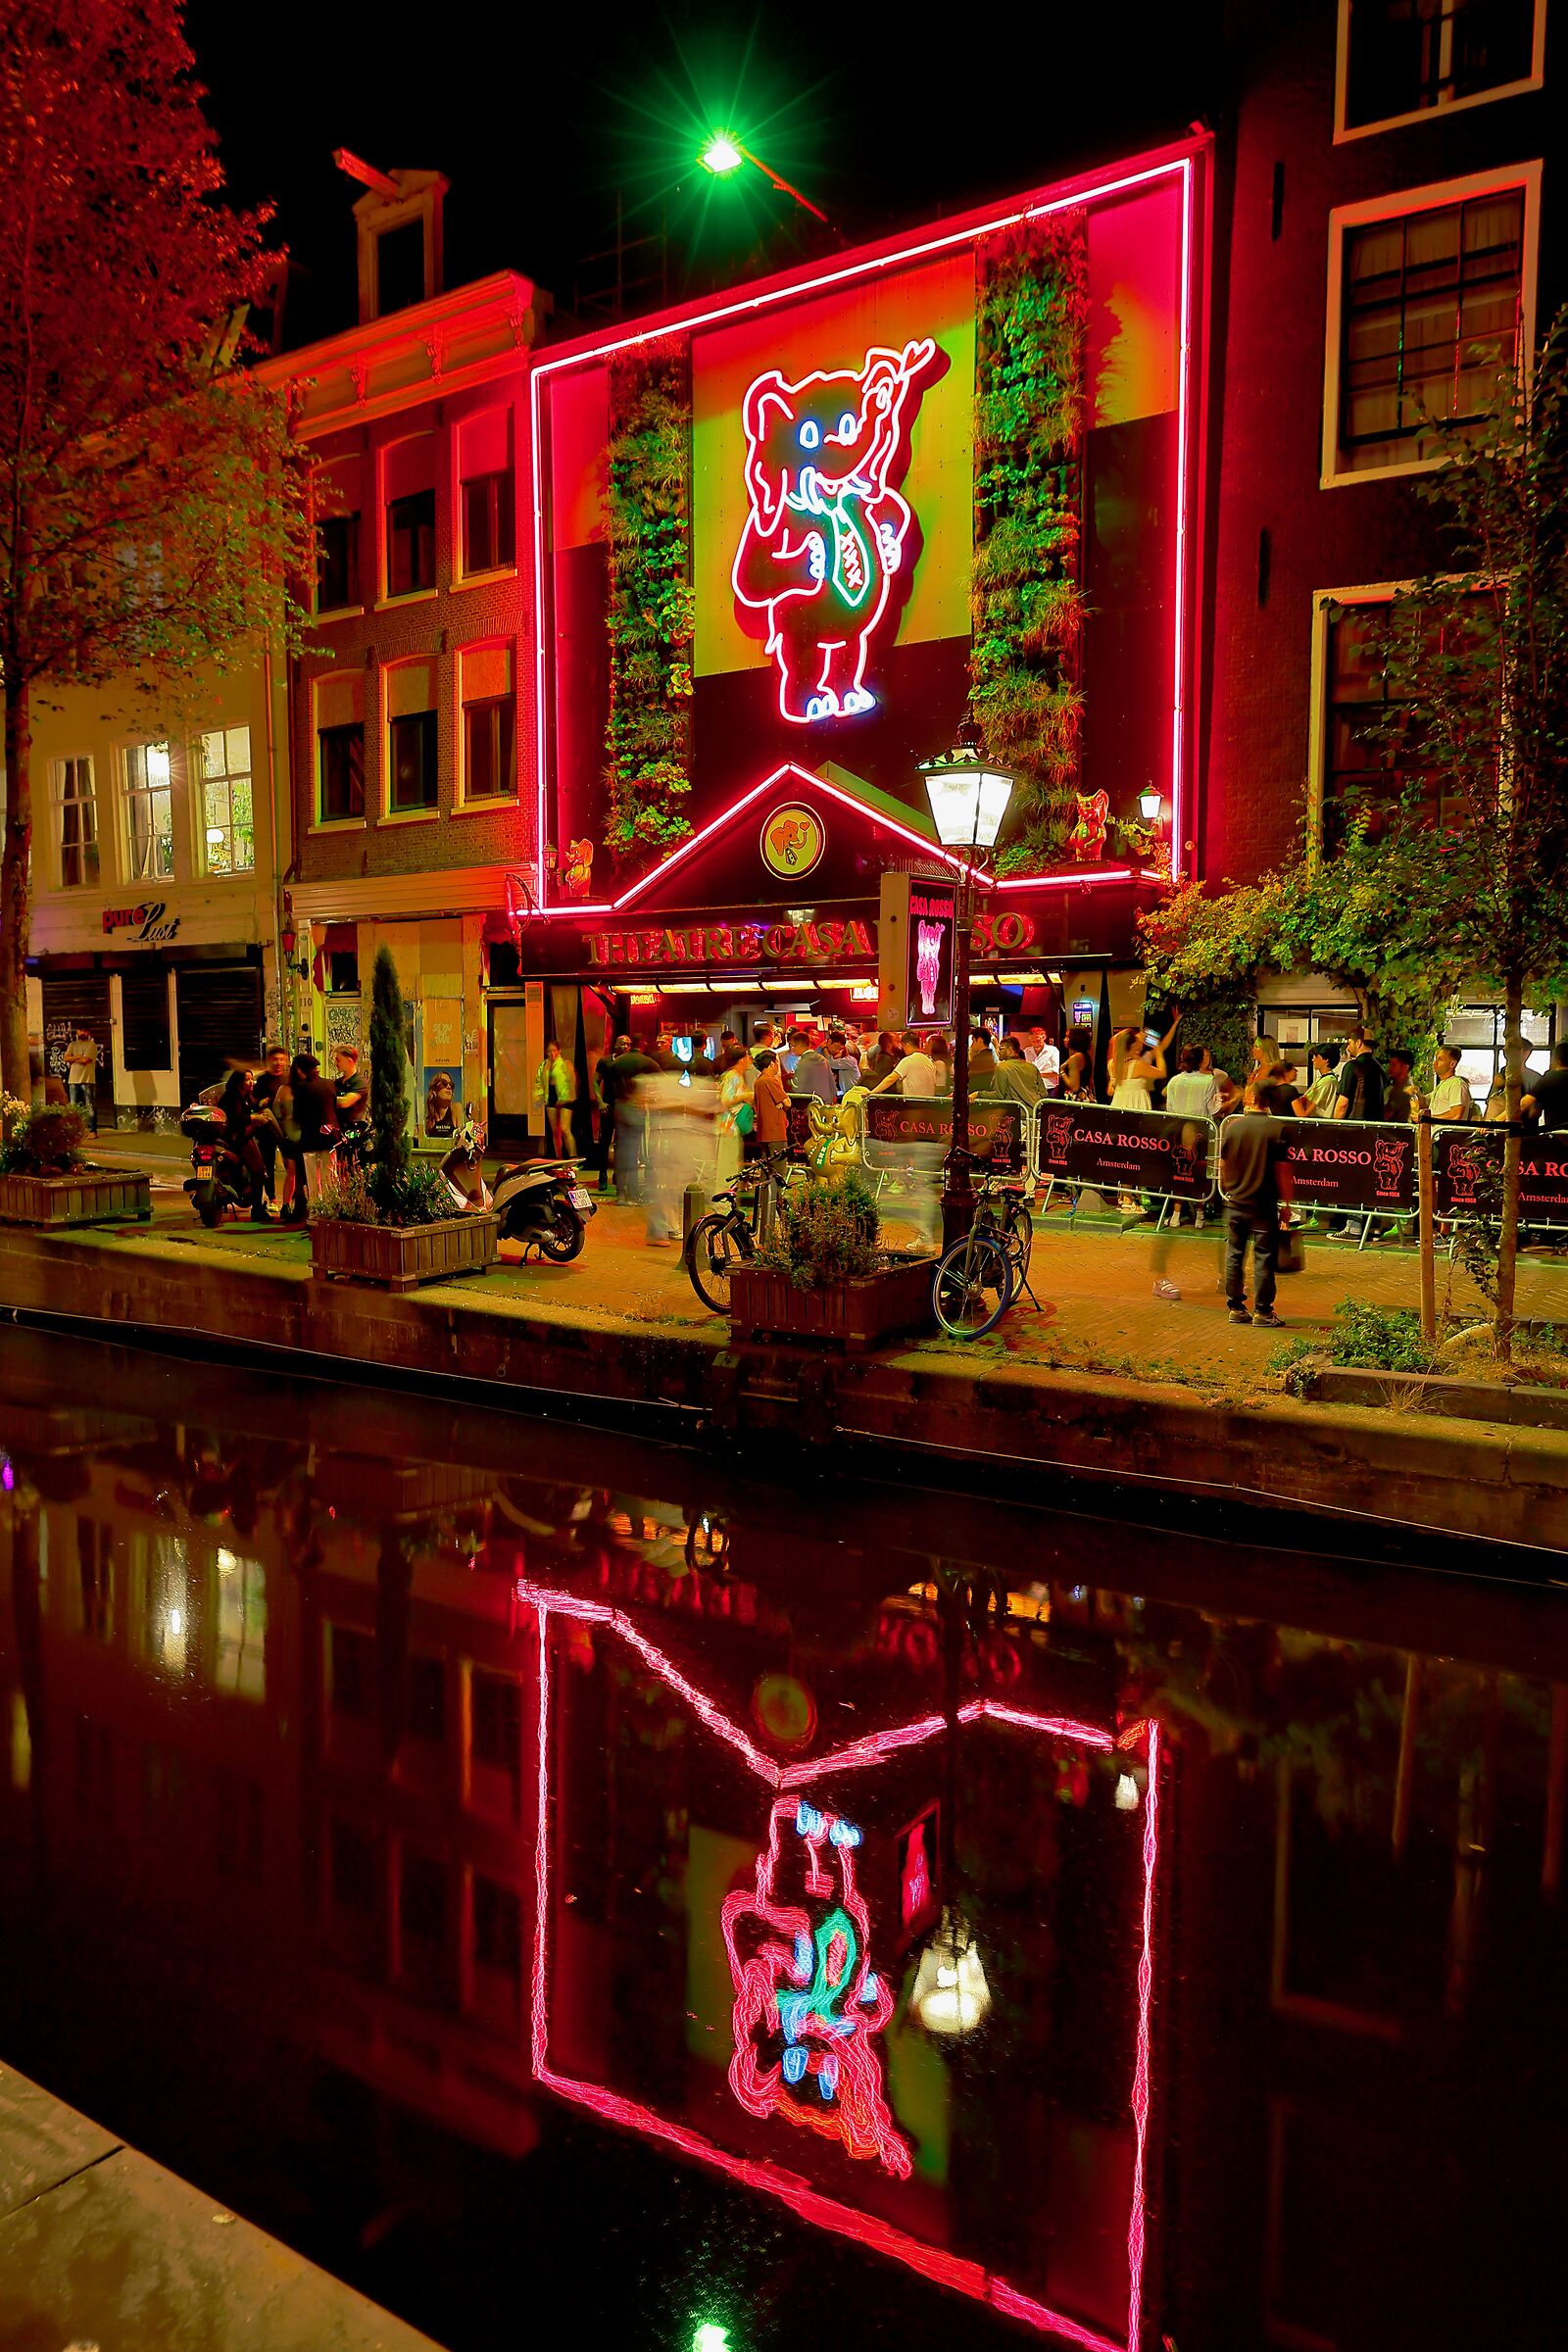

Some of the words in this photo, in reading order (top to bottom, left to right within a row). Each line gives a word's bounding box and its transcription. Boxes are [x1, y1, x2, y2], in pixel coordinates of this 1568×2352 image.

[909, 895, 928, 915] CASA
[102, 907, 146, 934] pure
[126, 902, 180, 942] Lust
[583, 927, 758, 964] THEATRE
[761, 920, 874, 959] CASA
[299, 997, 313, 1006] 110
[900, 1120, 935, 1135] CASA
[939, 1123, 987, 1137] RSO
[1073, 1128, 1114, 1146] CASA
[1117, 1134, 1171, 1152] ROSSO
[1096, 1157, 1141, 1171] Amsterdam
[1287, 1146, 1308, 1161] SA
[1311, 1148, 1372, 1165] ROSSO
[1292, 1175, 1339, 1188] Amsterdam
[1518, 1192, 1568, 1204] Amsterda
